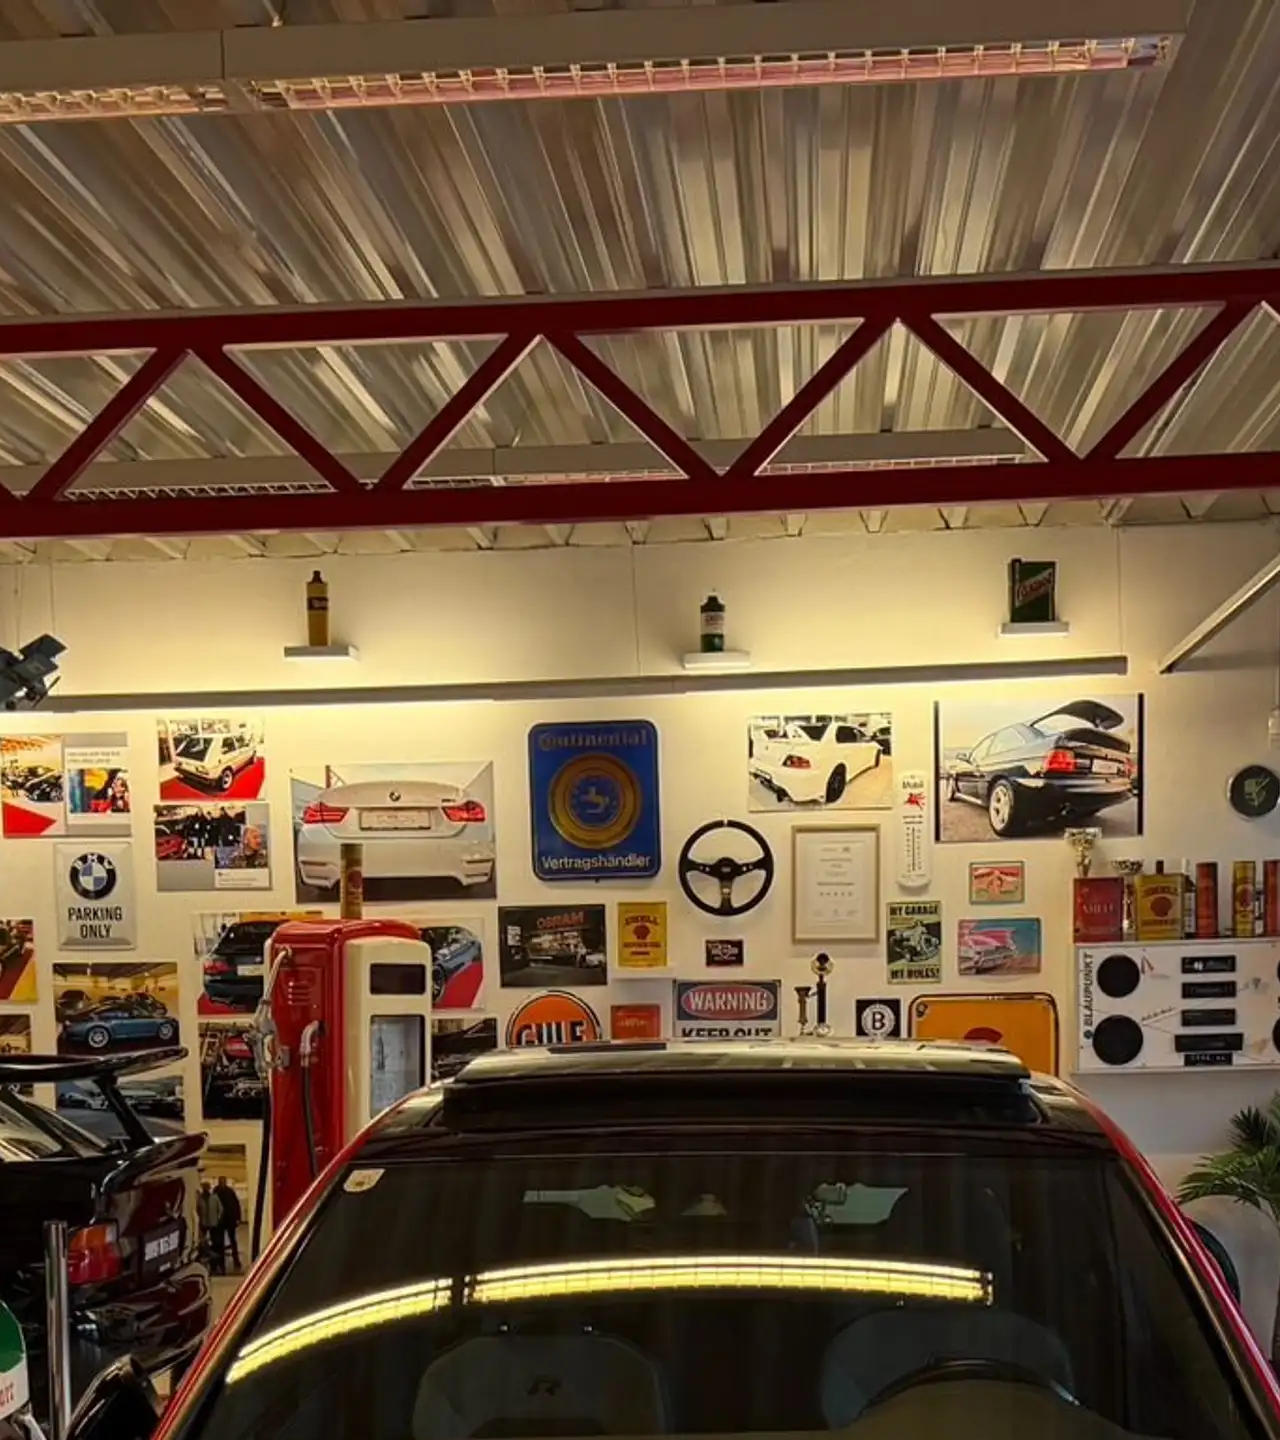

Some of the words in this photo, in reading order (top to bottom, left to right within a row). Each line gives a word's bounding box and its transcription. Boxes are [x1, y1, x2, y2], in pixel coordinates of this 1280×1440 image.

[541, 852, 651, 871] Vertragshändler
[68, 906, 123, 922] PARKING
[536, 911, 585, 929] OSRAM
[80, 923, 112, 939] ONLY
[1083, 952, 1095, 1027] BLAUPUNKT
[690, 991, 769, 1012] WARNING
